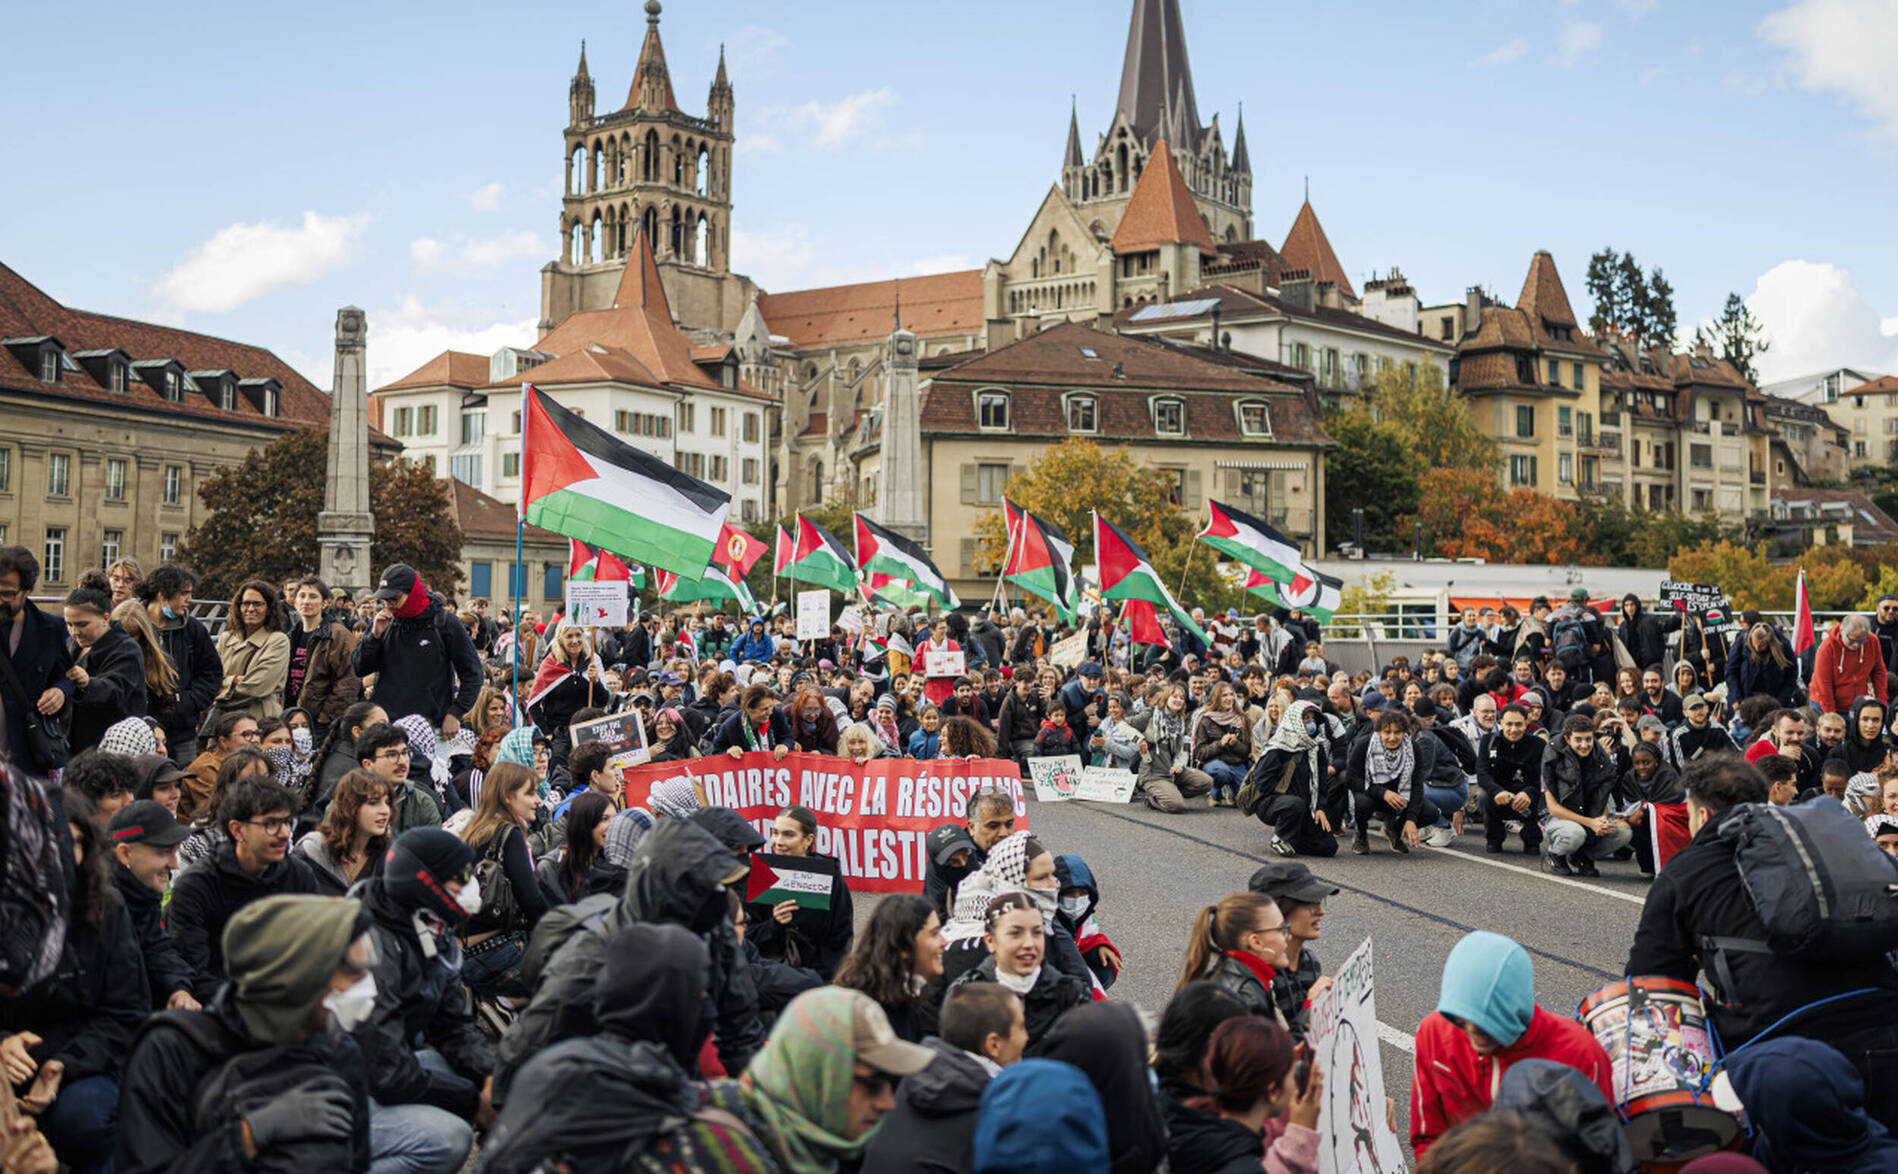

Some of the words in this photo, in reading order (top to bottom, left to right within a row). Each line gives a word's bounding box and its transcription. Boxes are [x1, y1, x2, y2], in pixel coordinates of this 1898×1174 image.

[646, 767, 791, 810] DAIRES
[800, 769, 855, 816] AVEC
[859, 776, 887, 816] LA
[896, 770, 1026, 818] RÉSISTC
[816, 825, 928, 880] PALESTI
[783, 879, 830, 892] GENOCIDE
[793, 872, 813, 880] END
